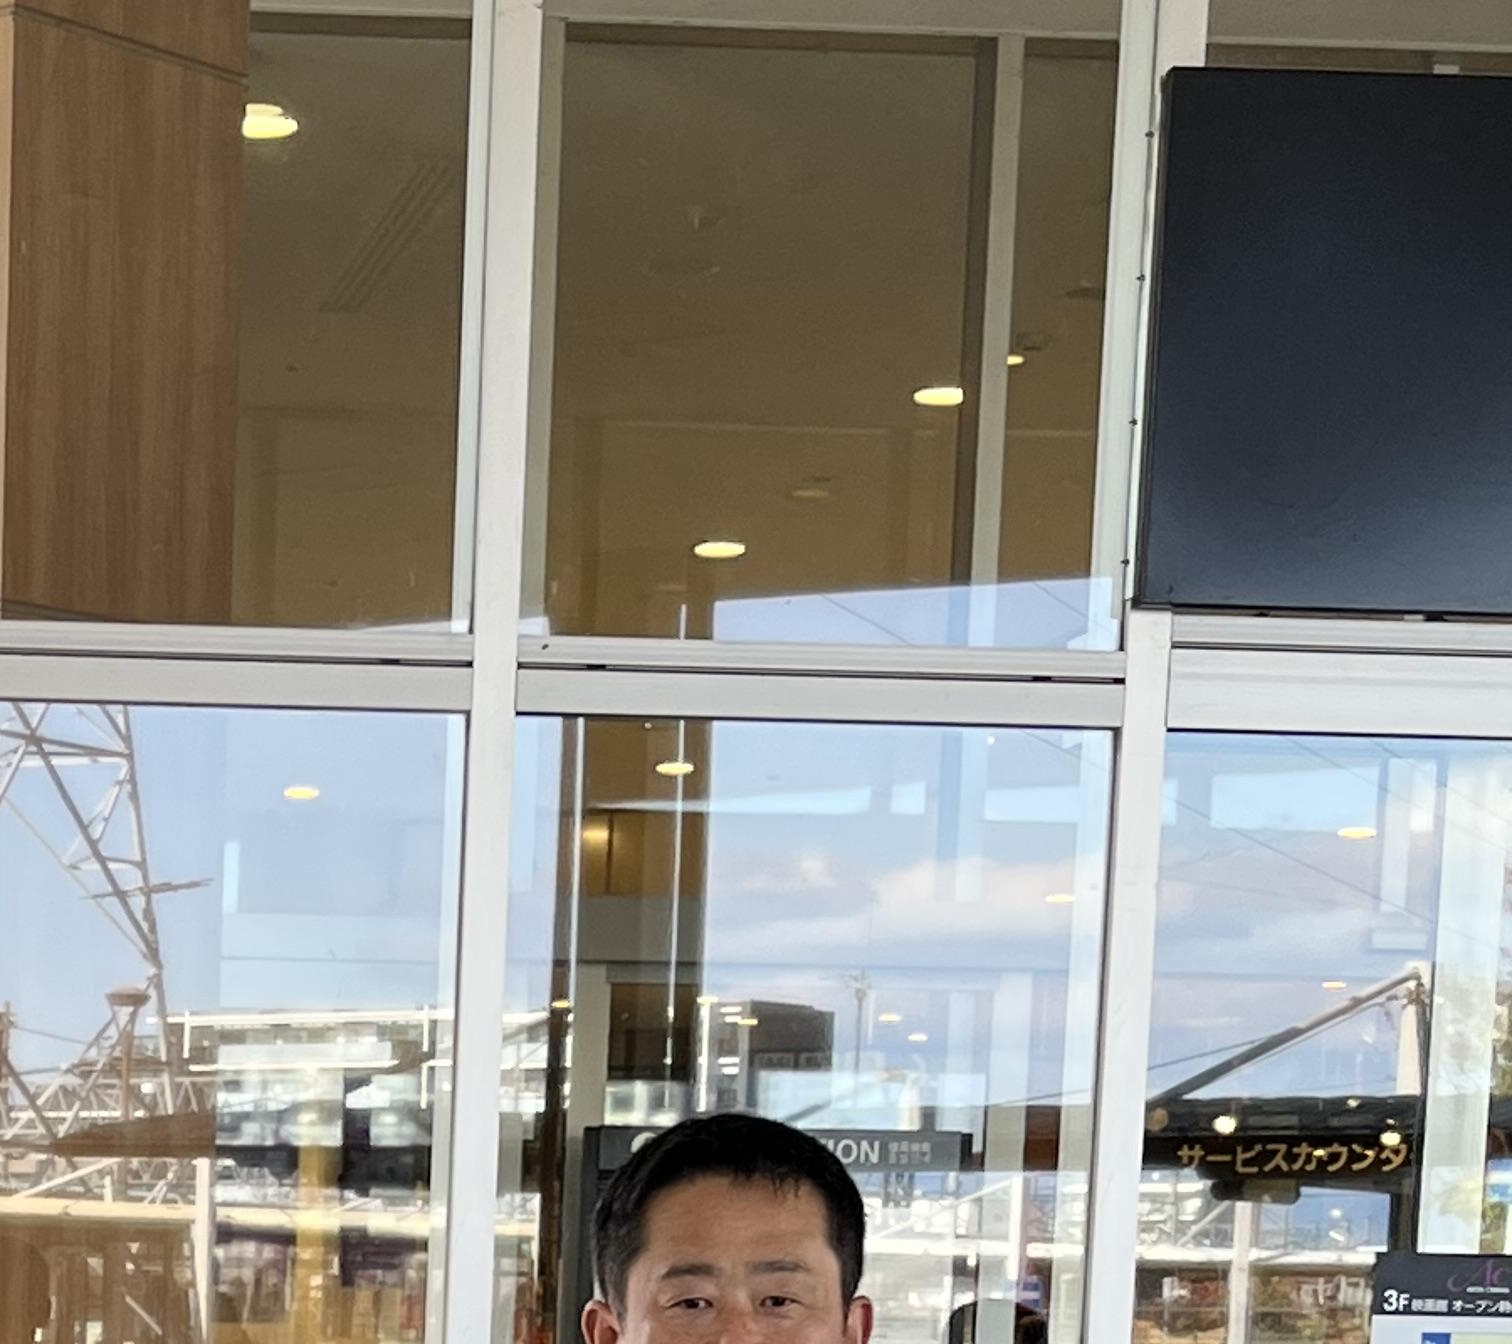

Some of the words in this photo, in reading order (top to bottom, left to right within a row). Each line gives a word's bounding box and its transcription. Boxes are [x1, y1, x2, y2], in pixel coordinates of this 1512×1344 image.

[1177, 1143, 1410, 1174] サービスカウンタ
